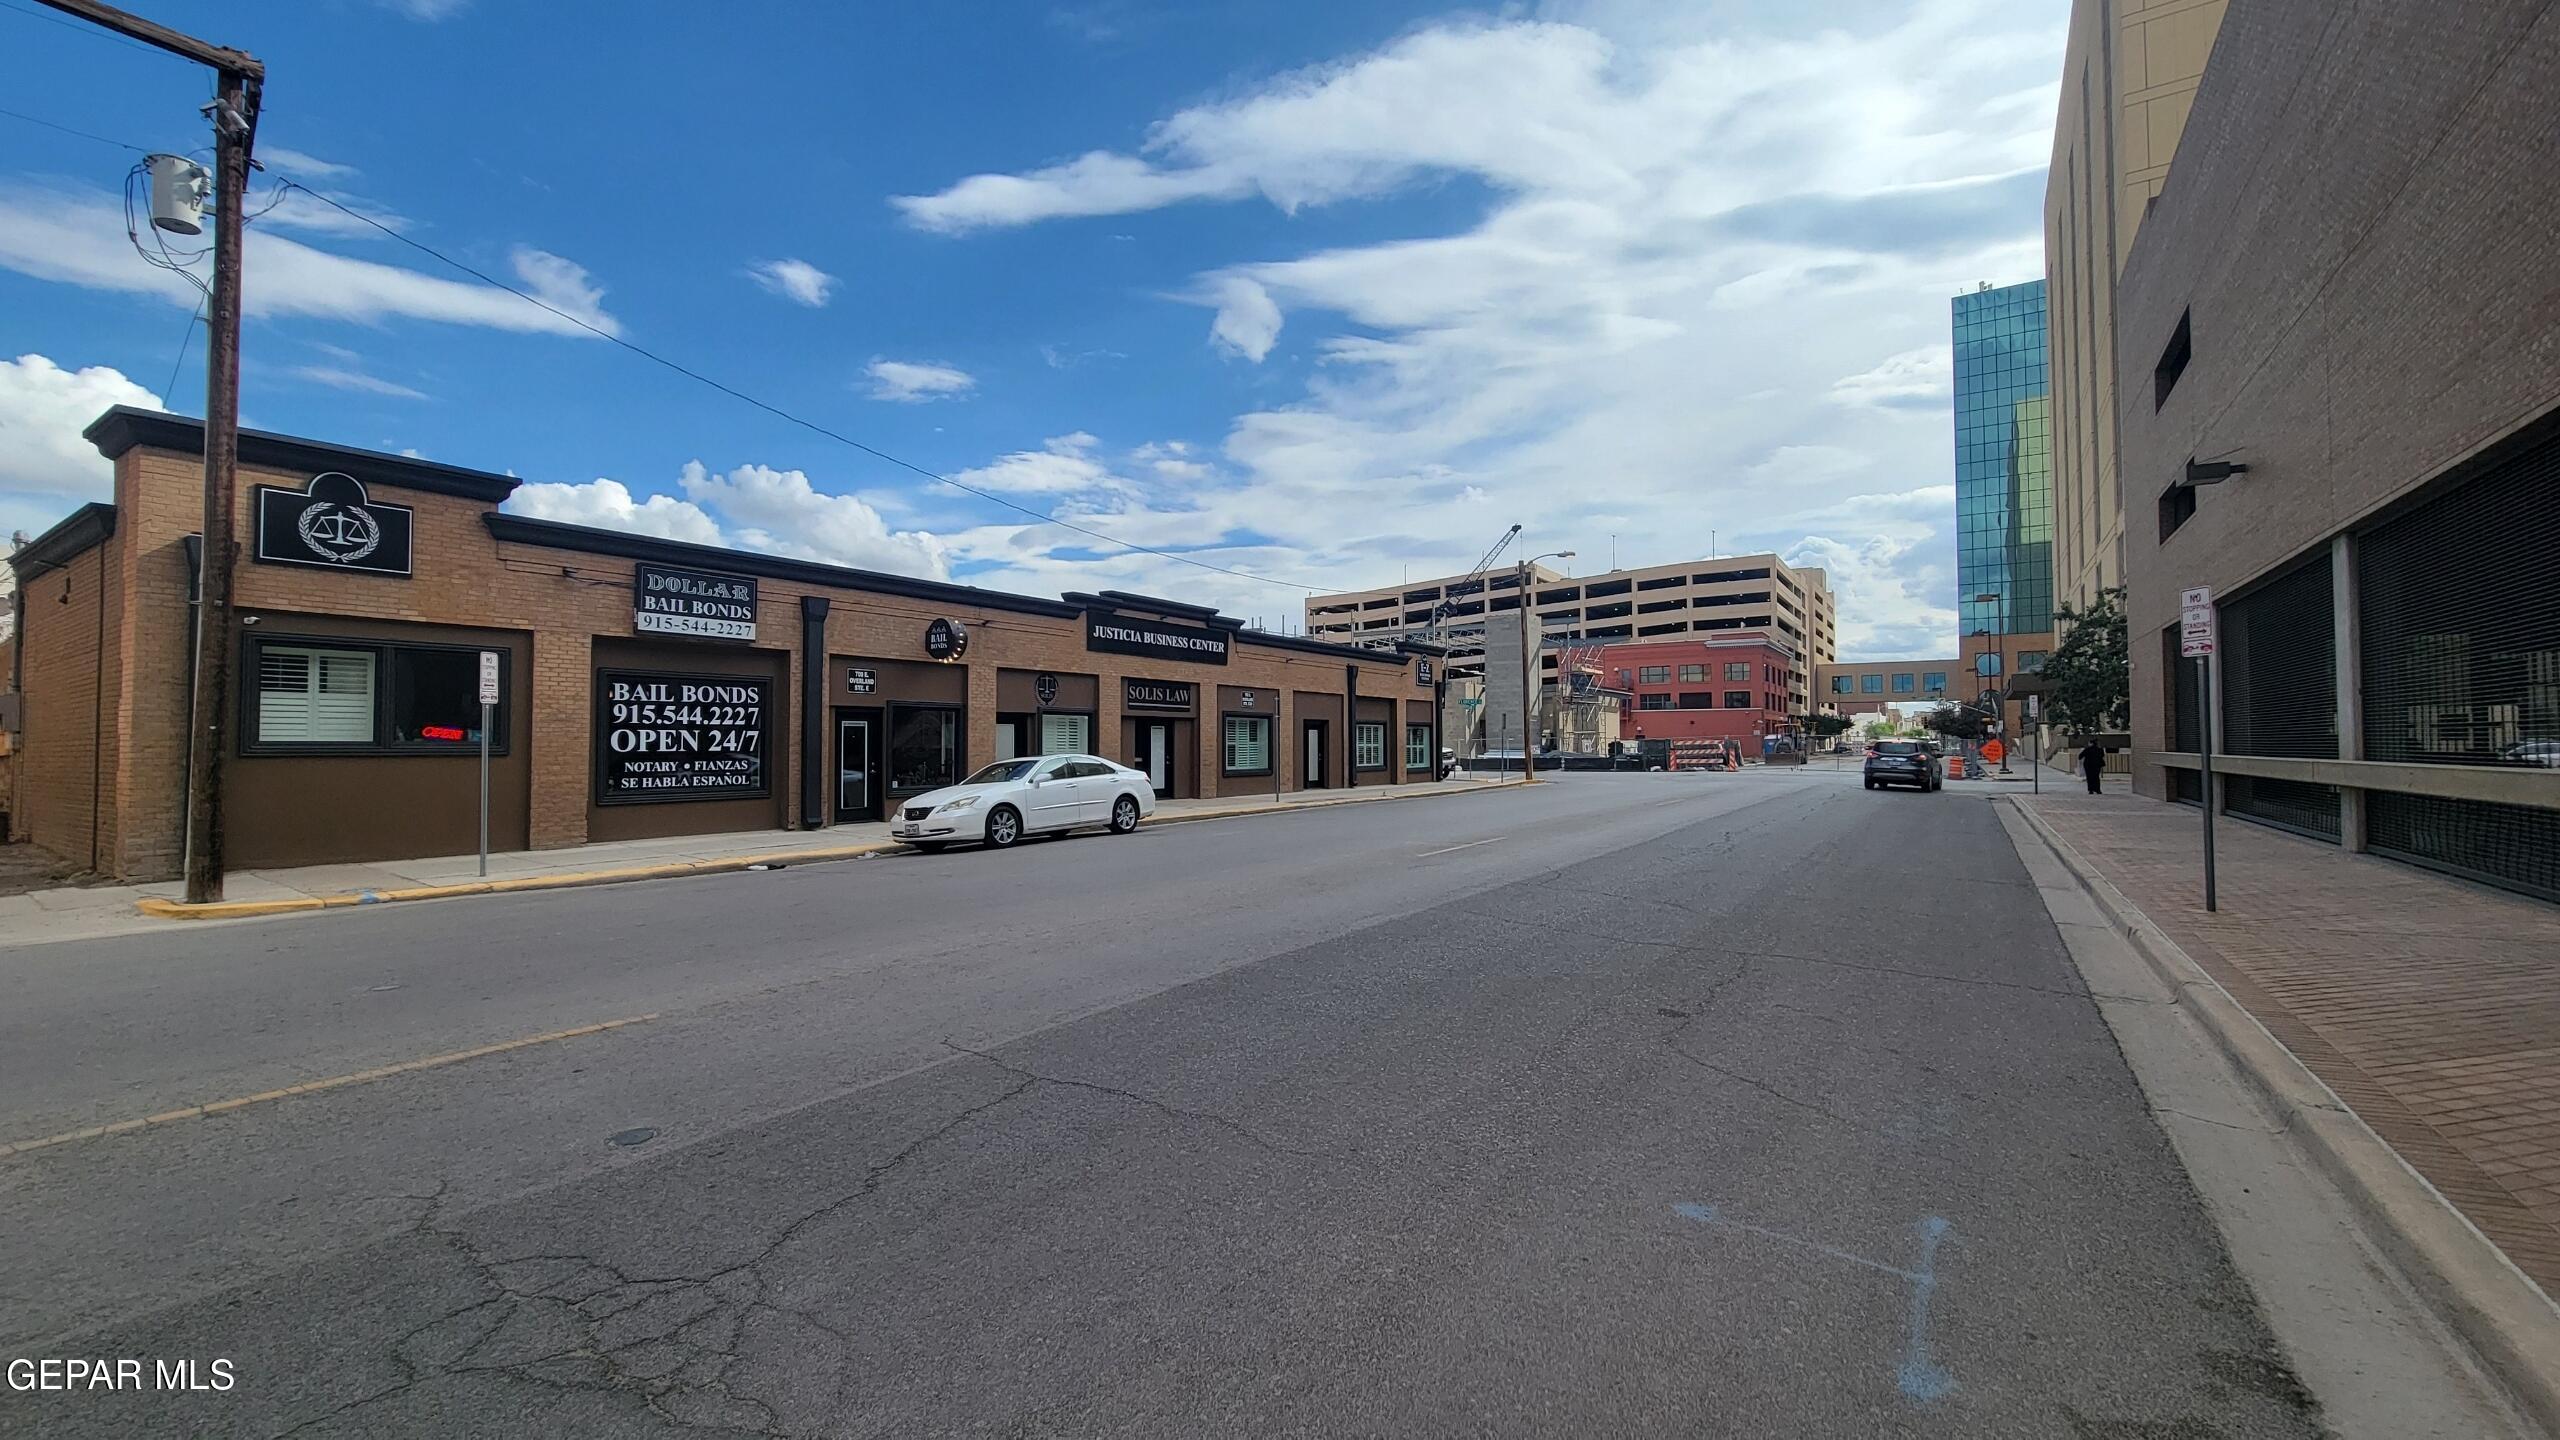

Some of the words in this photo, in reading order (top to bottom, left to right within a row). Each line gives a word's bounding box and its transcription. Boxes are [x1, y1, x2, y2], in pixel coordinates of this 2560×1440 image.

[647, 574, 750, 602] DOLLAR
[2190, 592, 2202, 603] NO
[644, 595, 688, 613] BAIL
[692, 600, 752, 620] BONDS
[643, 614, 752, 637] 915-544-2227
[930, 633, 948, 643] BAIL
[1093, 625, 1142, 643] JUSTICIA
[1143, 631, 1189, 649] BUSINESS
[1189, 638, 1225, 653] CENTER
[612, 682, 675, 702] BAIL
[680, 684, 759, 704] BONDS
[1128, 685, 1163, 701] SOLIS
[1166, 688, 1190, 703] LAW
[611, 703, 759, 726] 915.544.2227
[421, 726, 464, 740] OPEN
[610, 728, 701, 753] OPEN
[707, 729, 760, 752] 24/7
[624, 761, 679, 773] NOTARY
[694, 760, 749, 771] FIANZAS
[621, 777, 639, 789] SE
[642, 776, 690, 788] HABLA
[692, 772, 750, 786] ESPAÑOL
